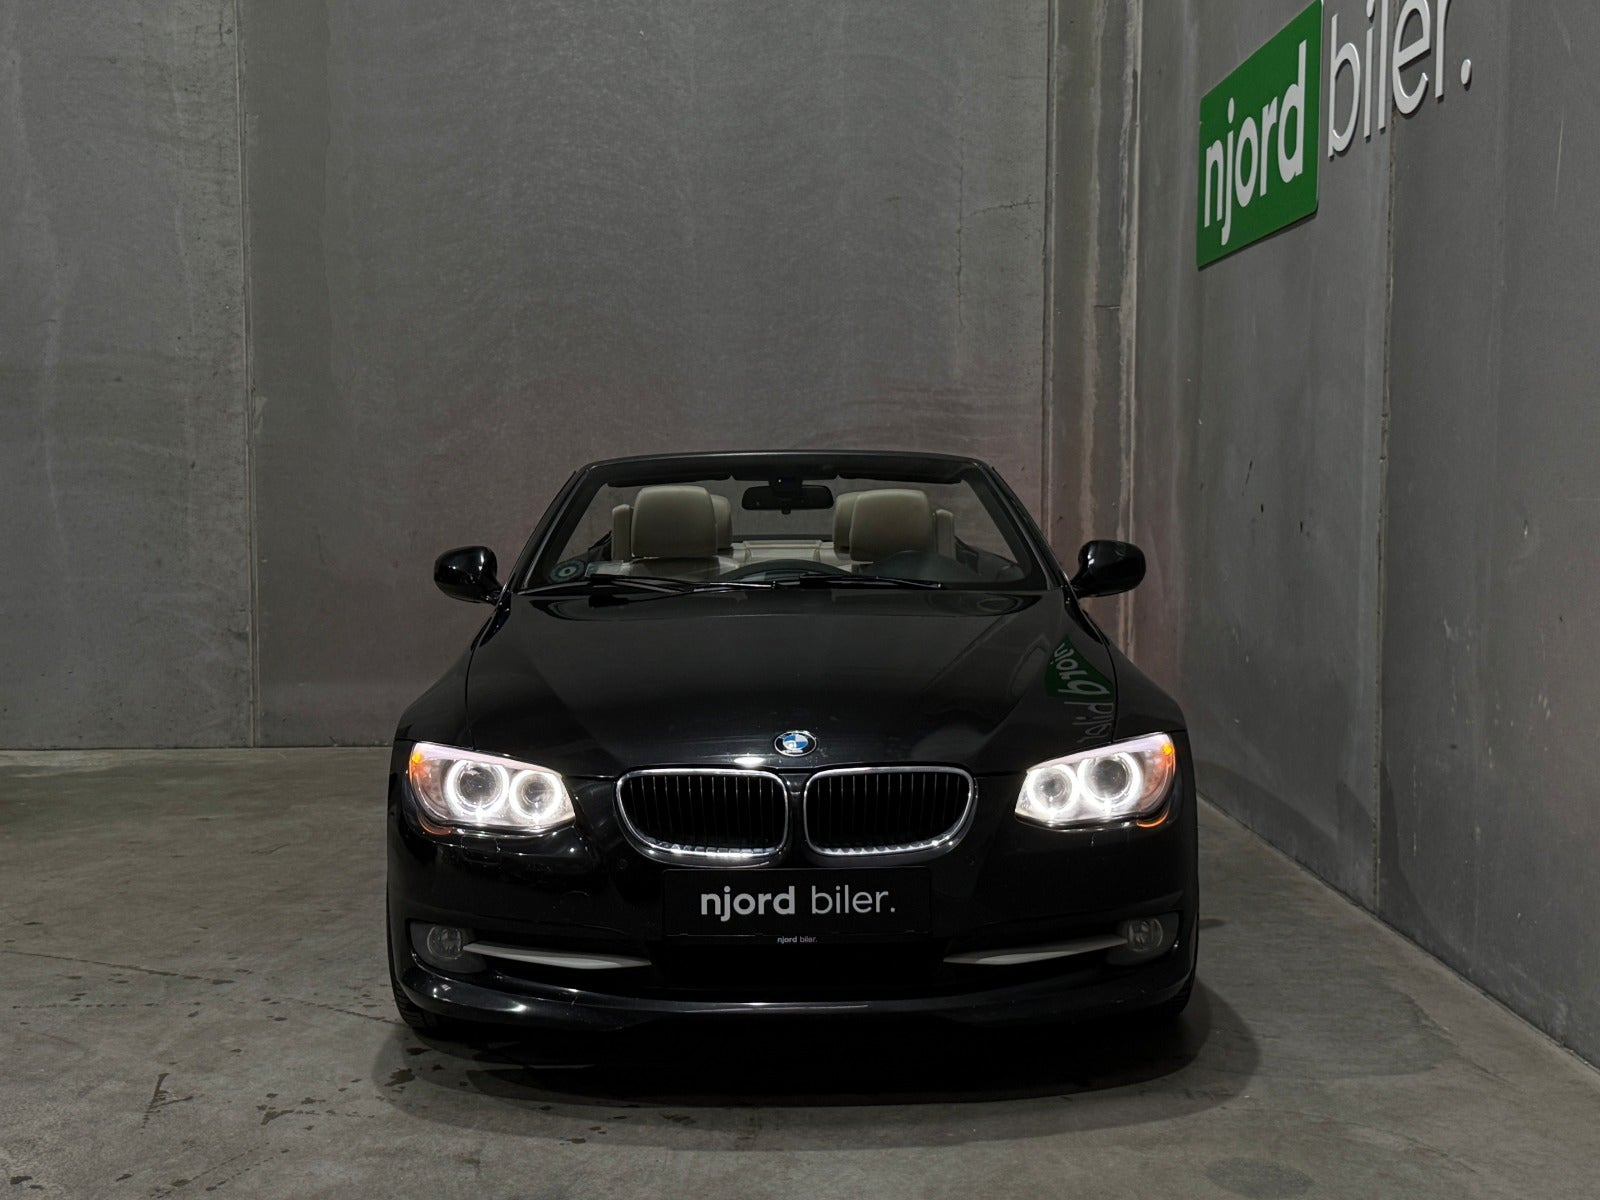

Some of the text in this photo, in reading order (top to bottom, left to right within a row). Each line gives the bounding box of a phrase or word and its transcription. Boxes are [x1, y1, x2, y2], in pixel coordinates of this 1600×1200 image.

[1204, 0, 1472, 246] njord biler.
[701, 884, 896, 922] njord biler.
[777, 936, 798, 944] njord
